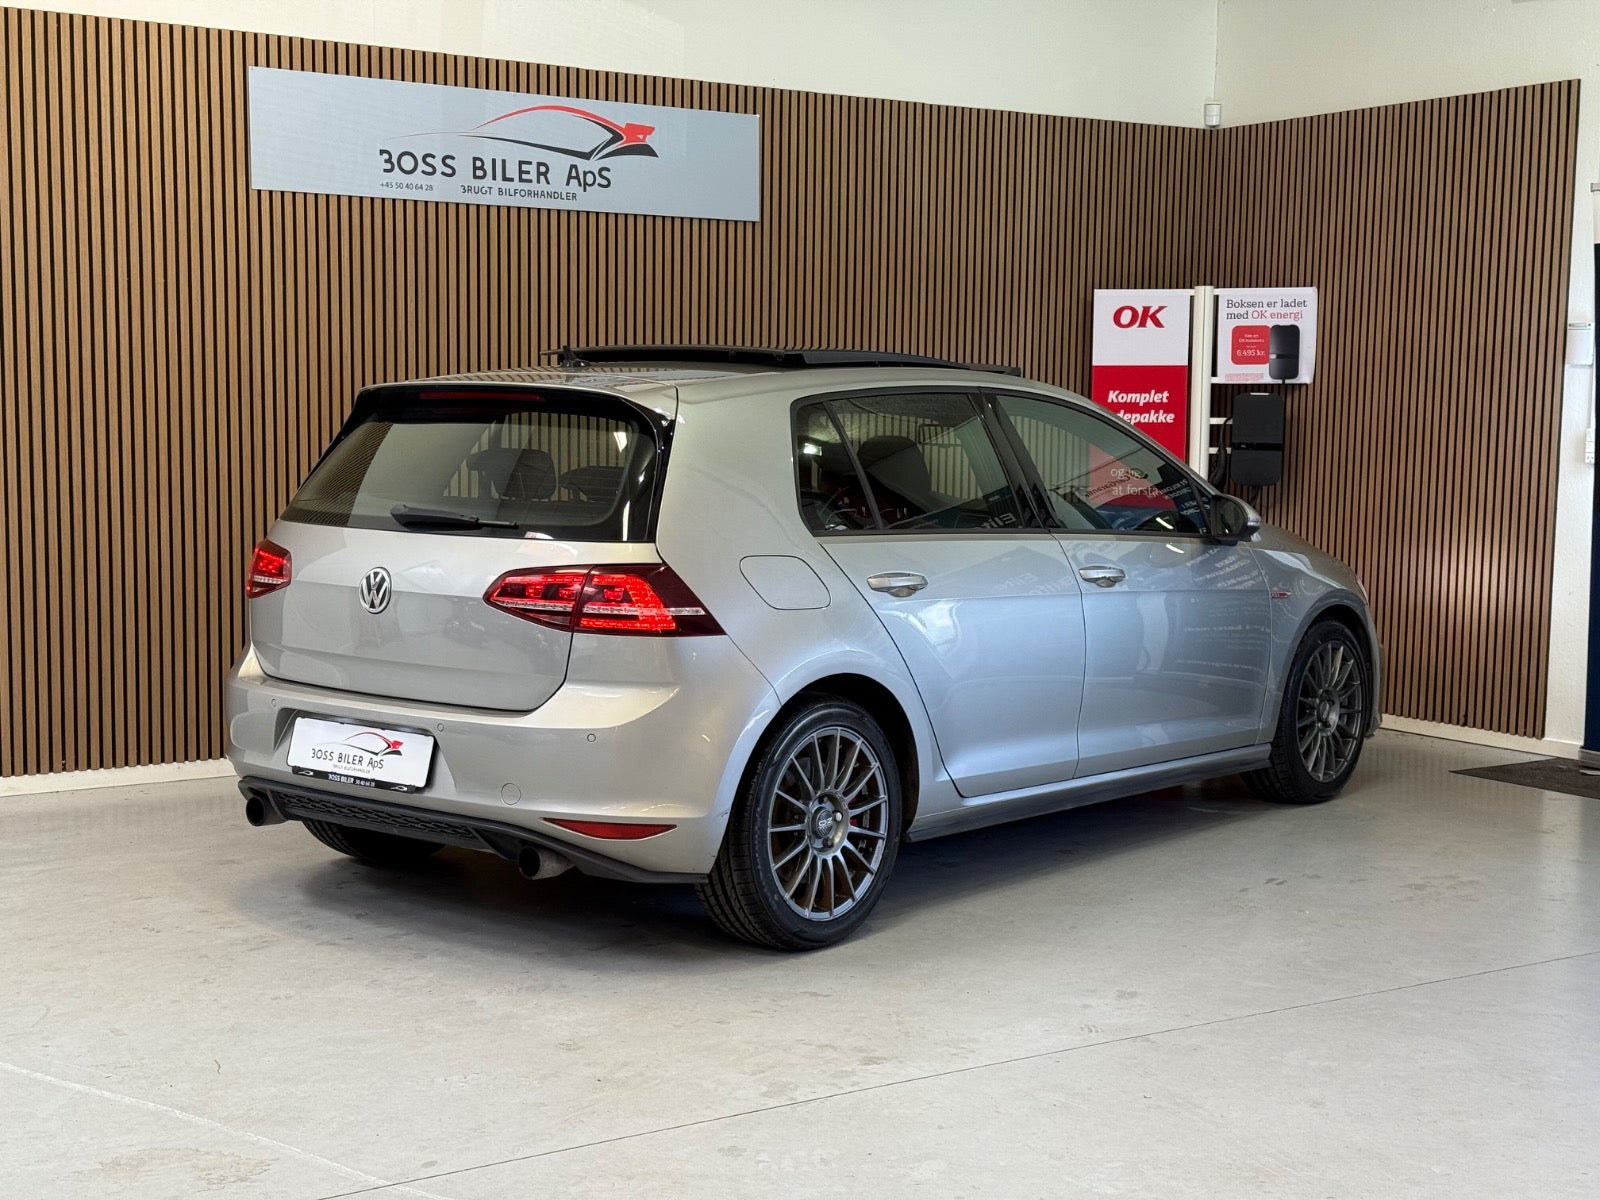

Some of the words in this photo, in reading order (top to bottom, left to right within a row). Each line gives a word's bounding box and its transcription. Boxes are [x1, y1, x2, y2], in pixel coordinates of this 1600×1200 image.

[472, 156, 551, 185] BILER
[565, 163, 612, 193] ApS
[414, 183, 424, 191] 64
[498, 188, 578, 201] BILFORHANDLER
[1226, 299, 1264, 309] Boksen
[1266, 300, 1279, 308] er
[1280, 298, 1307, 308] ladet
[1112, 305, 1168, 329] OK
[1226, 310, 1249, 320] med
[1251, 310, 1268, 319] OK
[1270, 310, 1303, 321] energi
[1107, 389, 1169, 407] Komplet
[337, 753, 364, 767] BILER
[366, 757, 385, 771] ApS
